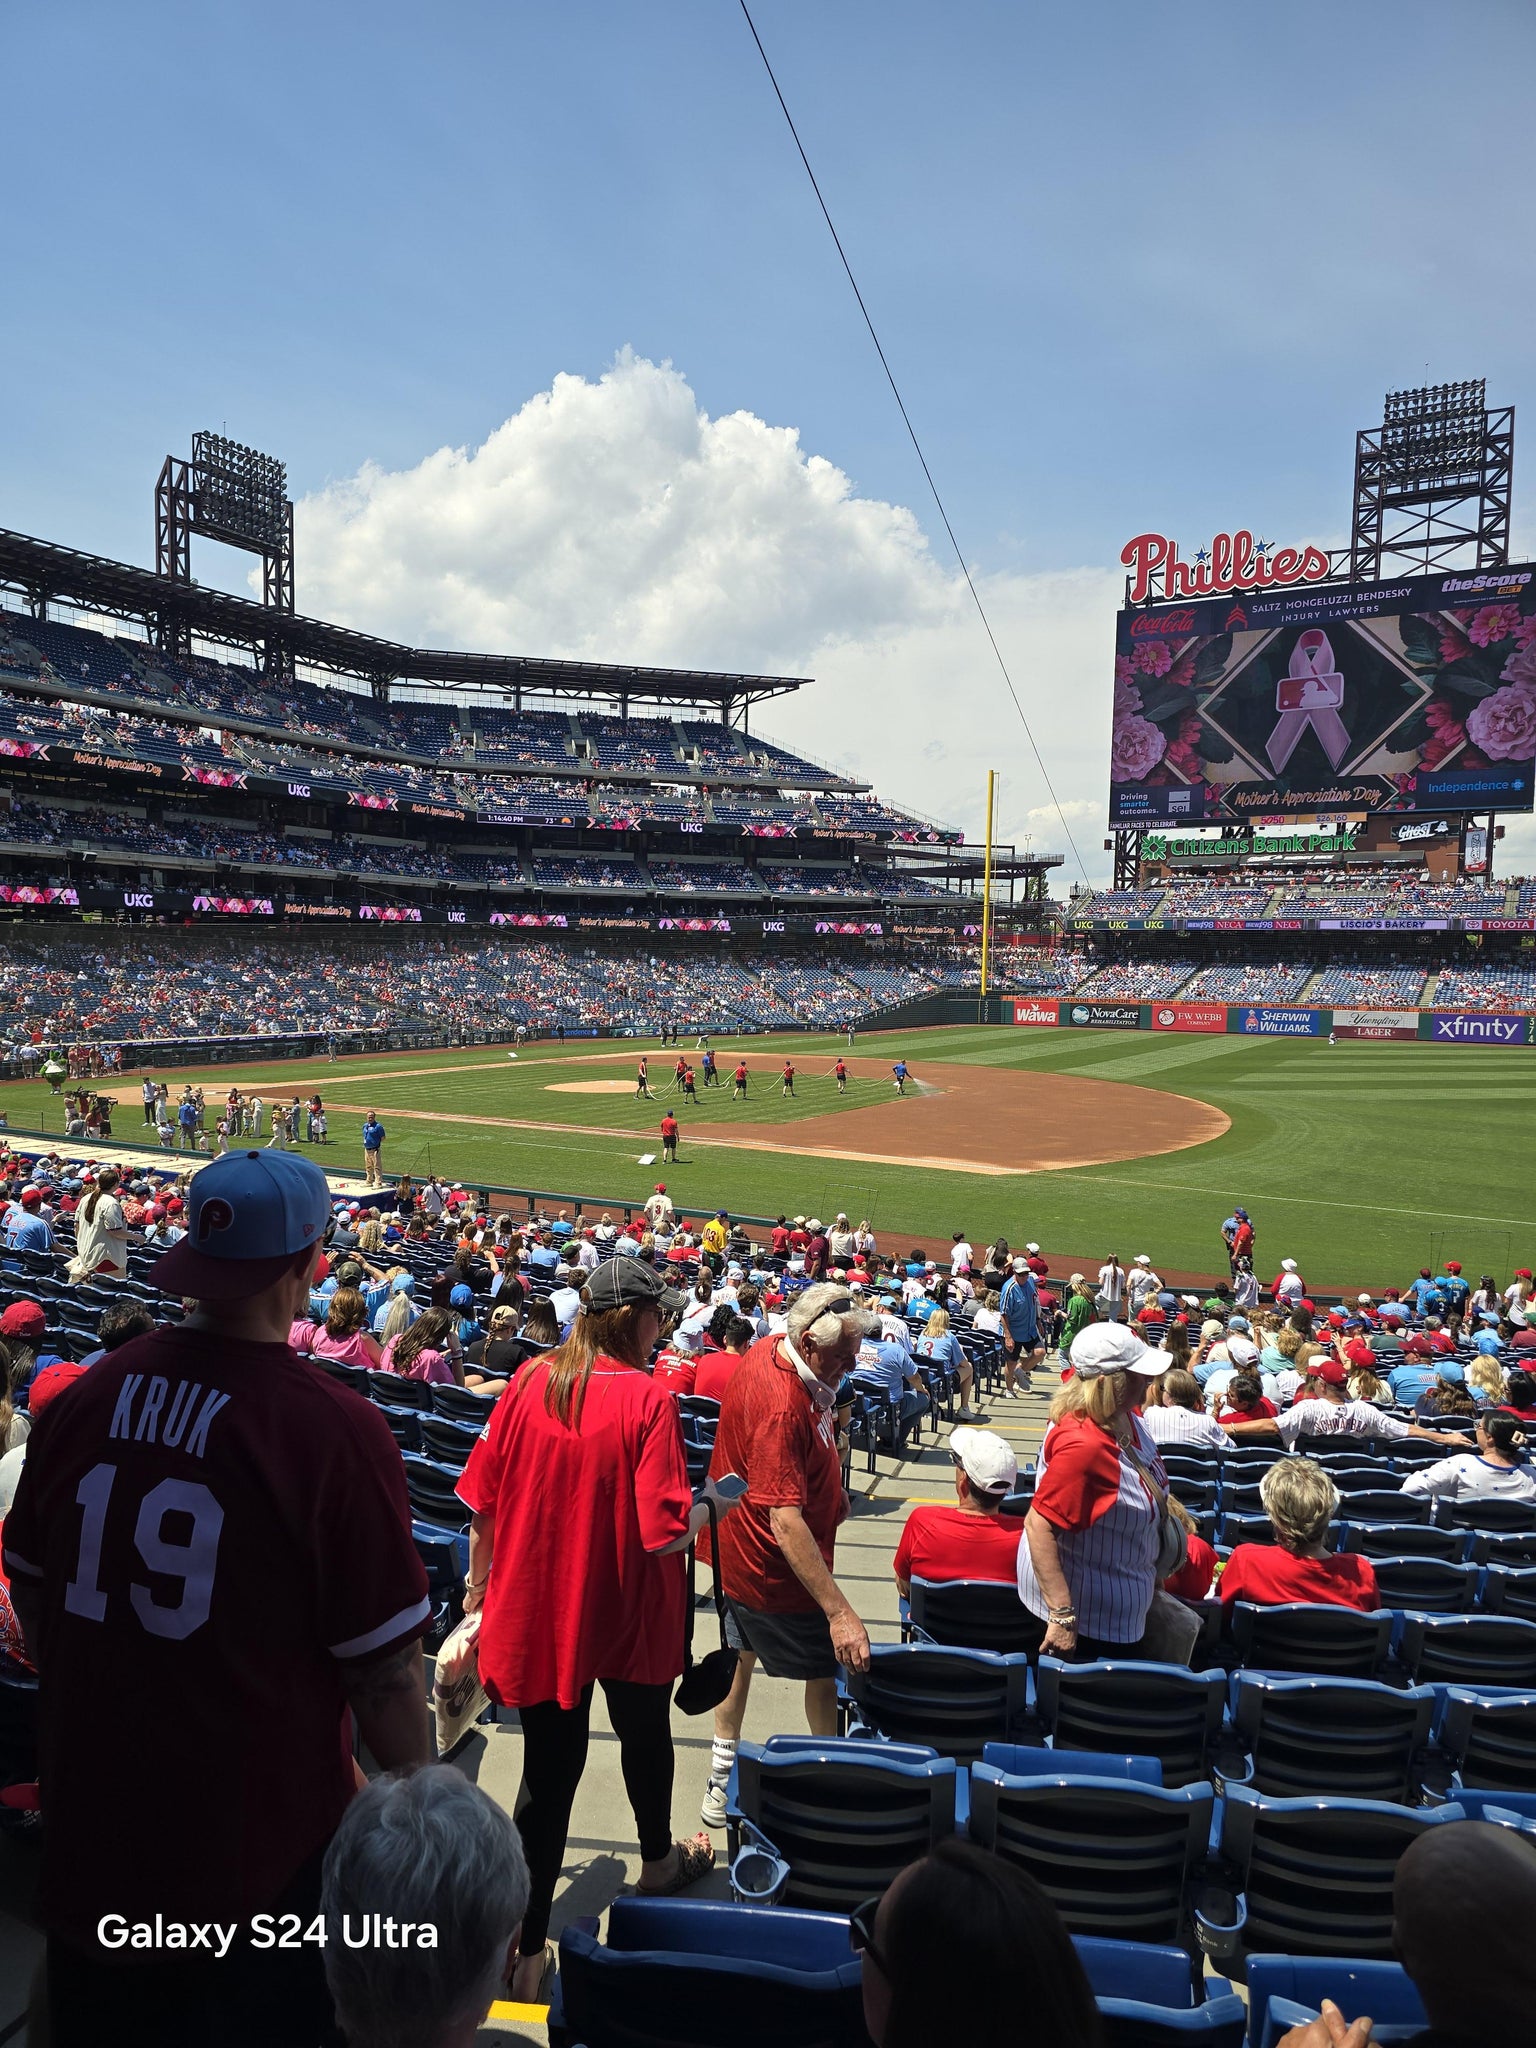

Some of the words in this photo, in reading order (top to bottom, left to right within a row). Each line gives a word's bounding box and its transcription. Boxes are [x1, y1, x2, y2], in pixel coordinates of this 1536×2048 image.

[1120, 529, 1330, 603] Phillies
[1441, 573, 1532, 592] theScore
[1252, 603, 1281, 613] SALTZ
[1286, 595, 1352, 608] MONGELUZZI
[1357, 588, 1412, 601] BENDESKY
[1281, 612, 1320, 622] INJURY
[1329, 605, 1380, 617] LAWYERS
[73, 752, 102, 766] Mother's
[103, 756, 145, 772] Appreciation
[146, 762, 163, 777] Day
[288, 783, 311, 797] UKG
[1428, 781, 1509, 793] Independence
[1120, 793, 1148, 801] Driving
[1234, 790, 1279, 807] Mother's
[1282, 787, 1352, 806] Appreciation
[1353, 787, 1382, 806] Day
[1316, 815, 1347, 823] $26,160
[681, 823, 703, 833] UKG
[1398, 821, 1439, 841] GHOST
[1171, 838, 1249, 856] Citizens
[1253, 834, 1305, 853] Bank
[1309, 832, 1356, 851] Park
[124, 893, 153, 907] UKG
[448, 912, 466, 923] UKG
[763, 922, 785, 932] UKG
[1074, 921, 1094, 929] UKG
[1108, 921, 1128, 929] UKG
[1144, 921, 1164, 929] UKG
[1217, 921, 1242, 929] NECA
[1276, 921, 1301, 929] NECA
[1486, 920, 1530, 929] TOYOTA
[1017, 1008, 1056, 1022] Wawa
[1091, 1008, 1139, 1019] NovaCare
[1196, 1013, 1222, 1021] WEBB
[1260, 1011, 1310, 1023] SHERWIN
[1349, 1012, 1402, 1027] Yuengling
[1358, 1027, 1391, 1036] LAGER
[1438, 1017, 1519, 1040] xfinity
[108, 1373, 231, 1458] KRUK
[65, 1462, 225, 1641] 19
